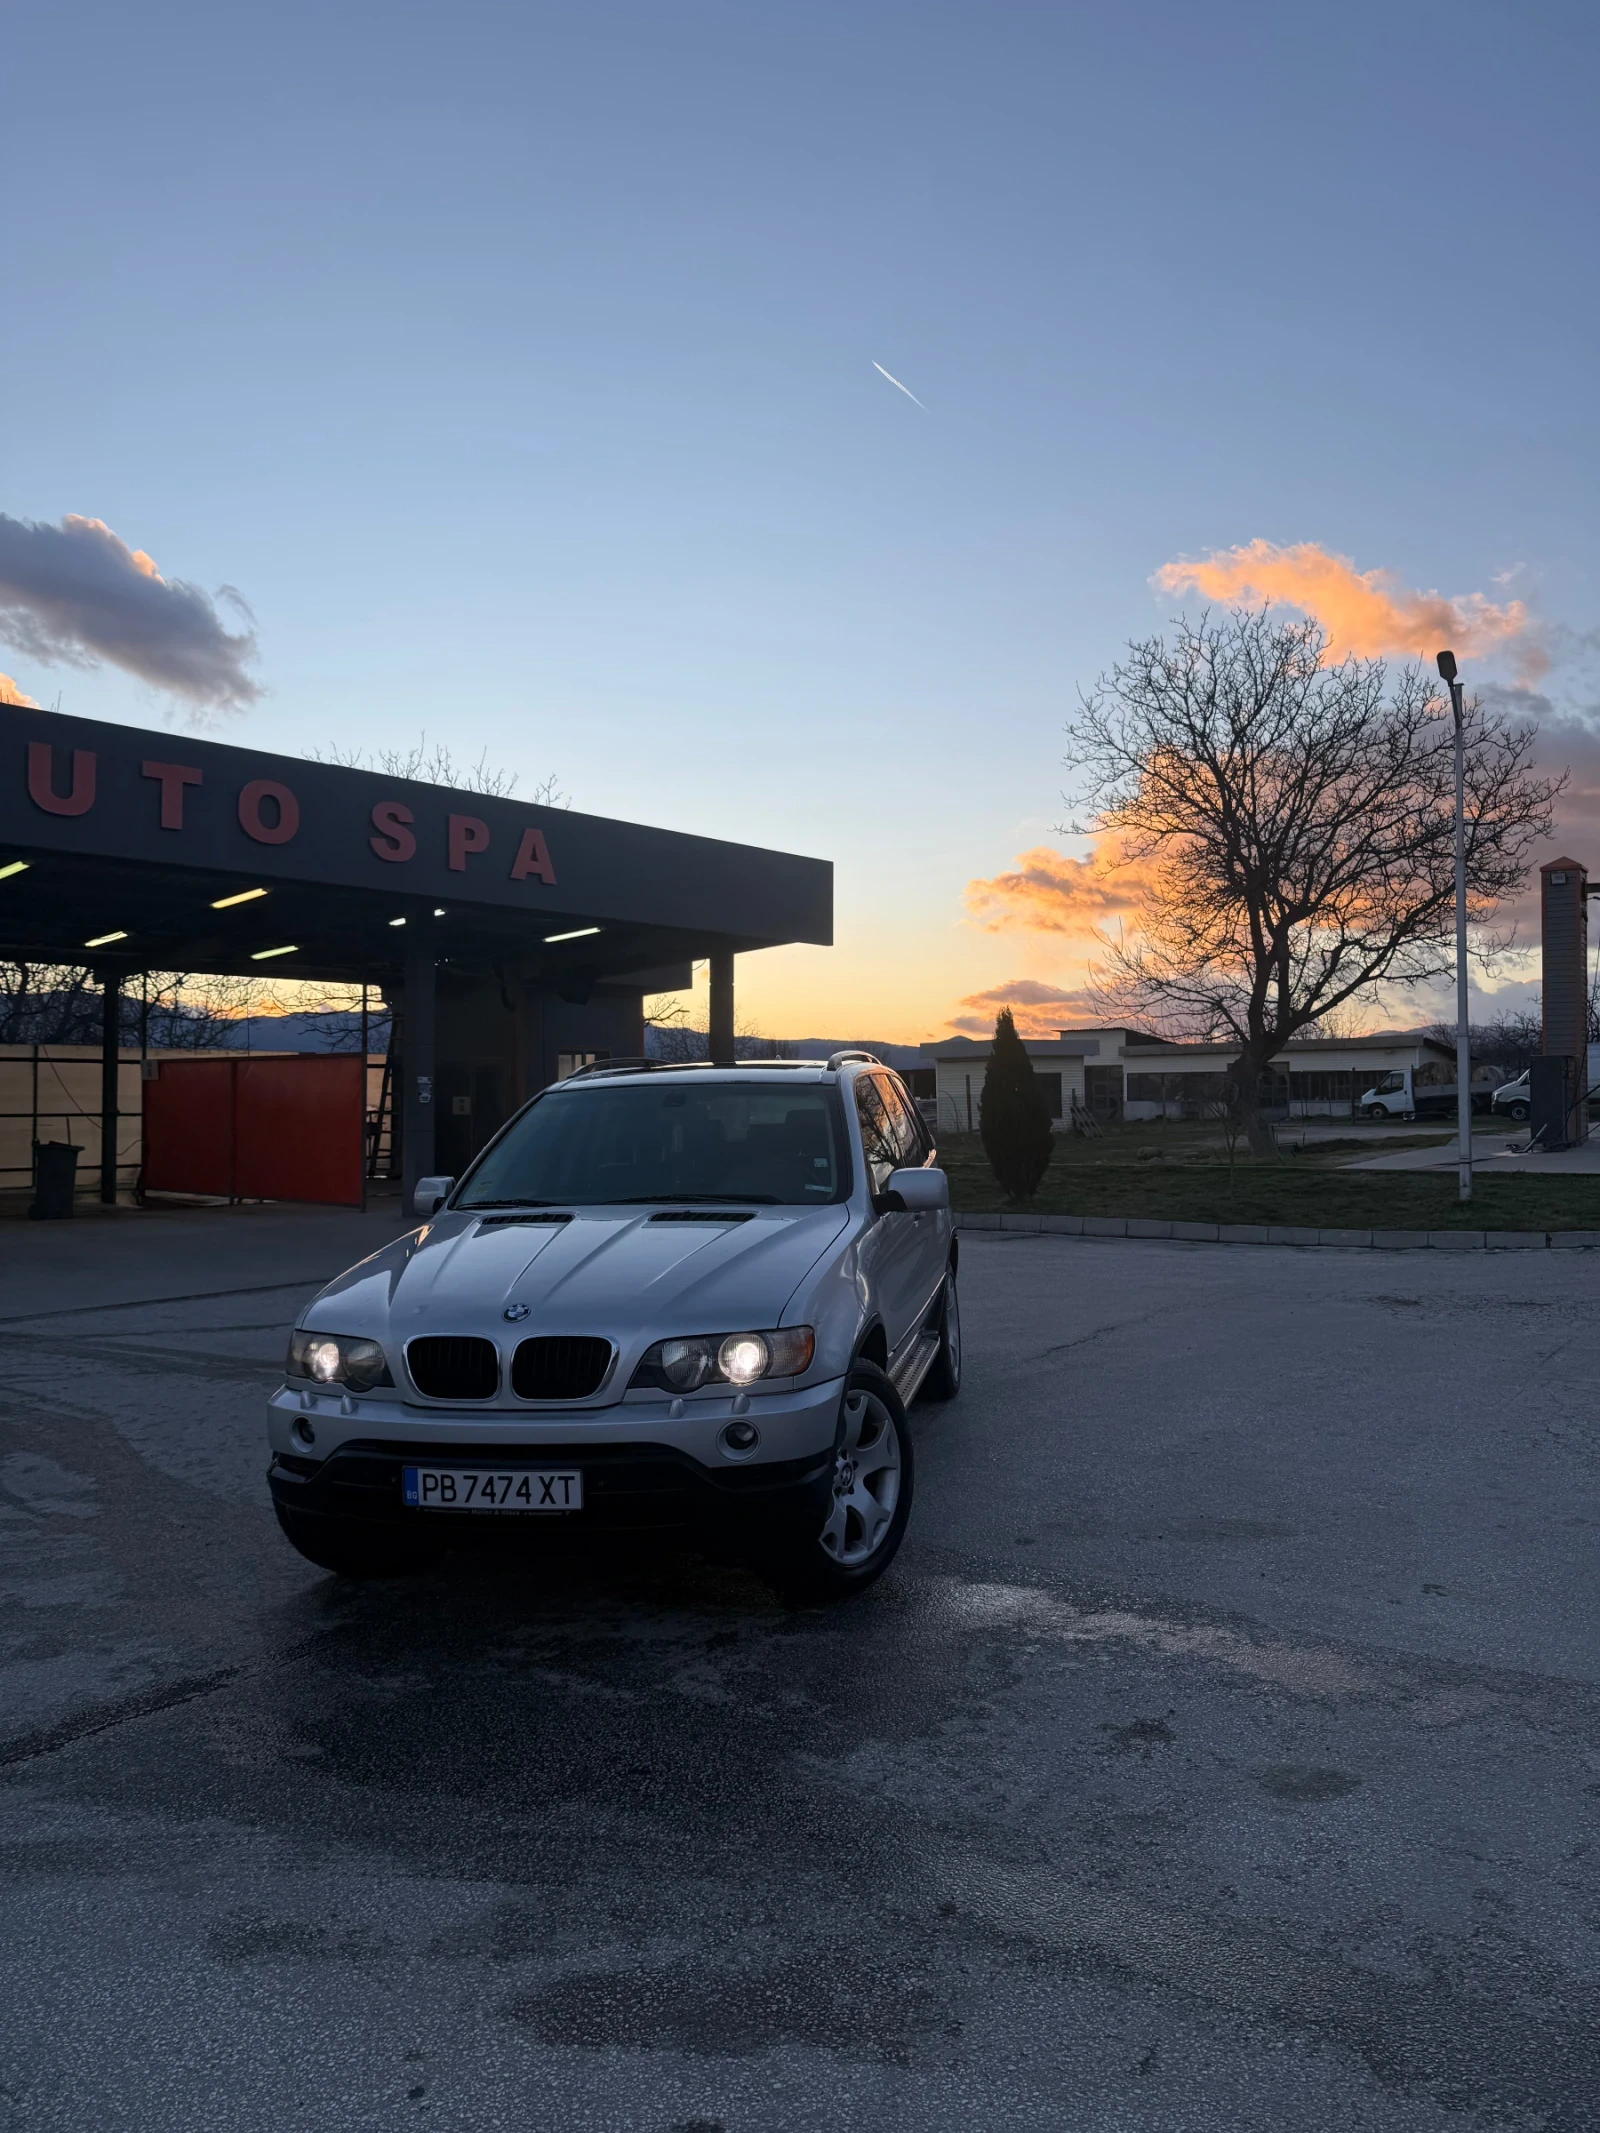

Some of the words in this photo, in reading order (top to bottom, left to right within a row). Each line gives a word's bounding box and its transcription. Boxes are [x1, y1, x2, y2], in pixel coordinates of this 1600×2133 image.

[28, 742, 300, 845] UTO
[369, 801, 557, 885] SPA
[406, 1490, 418, 1500] BG
